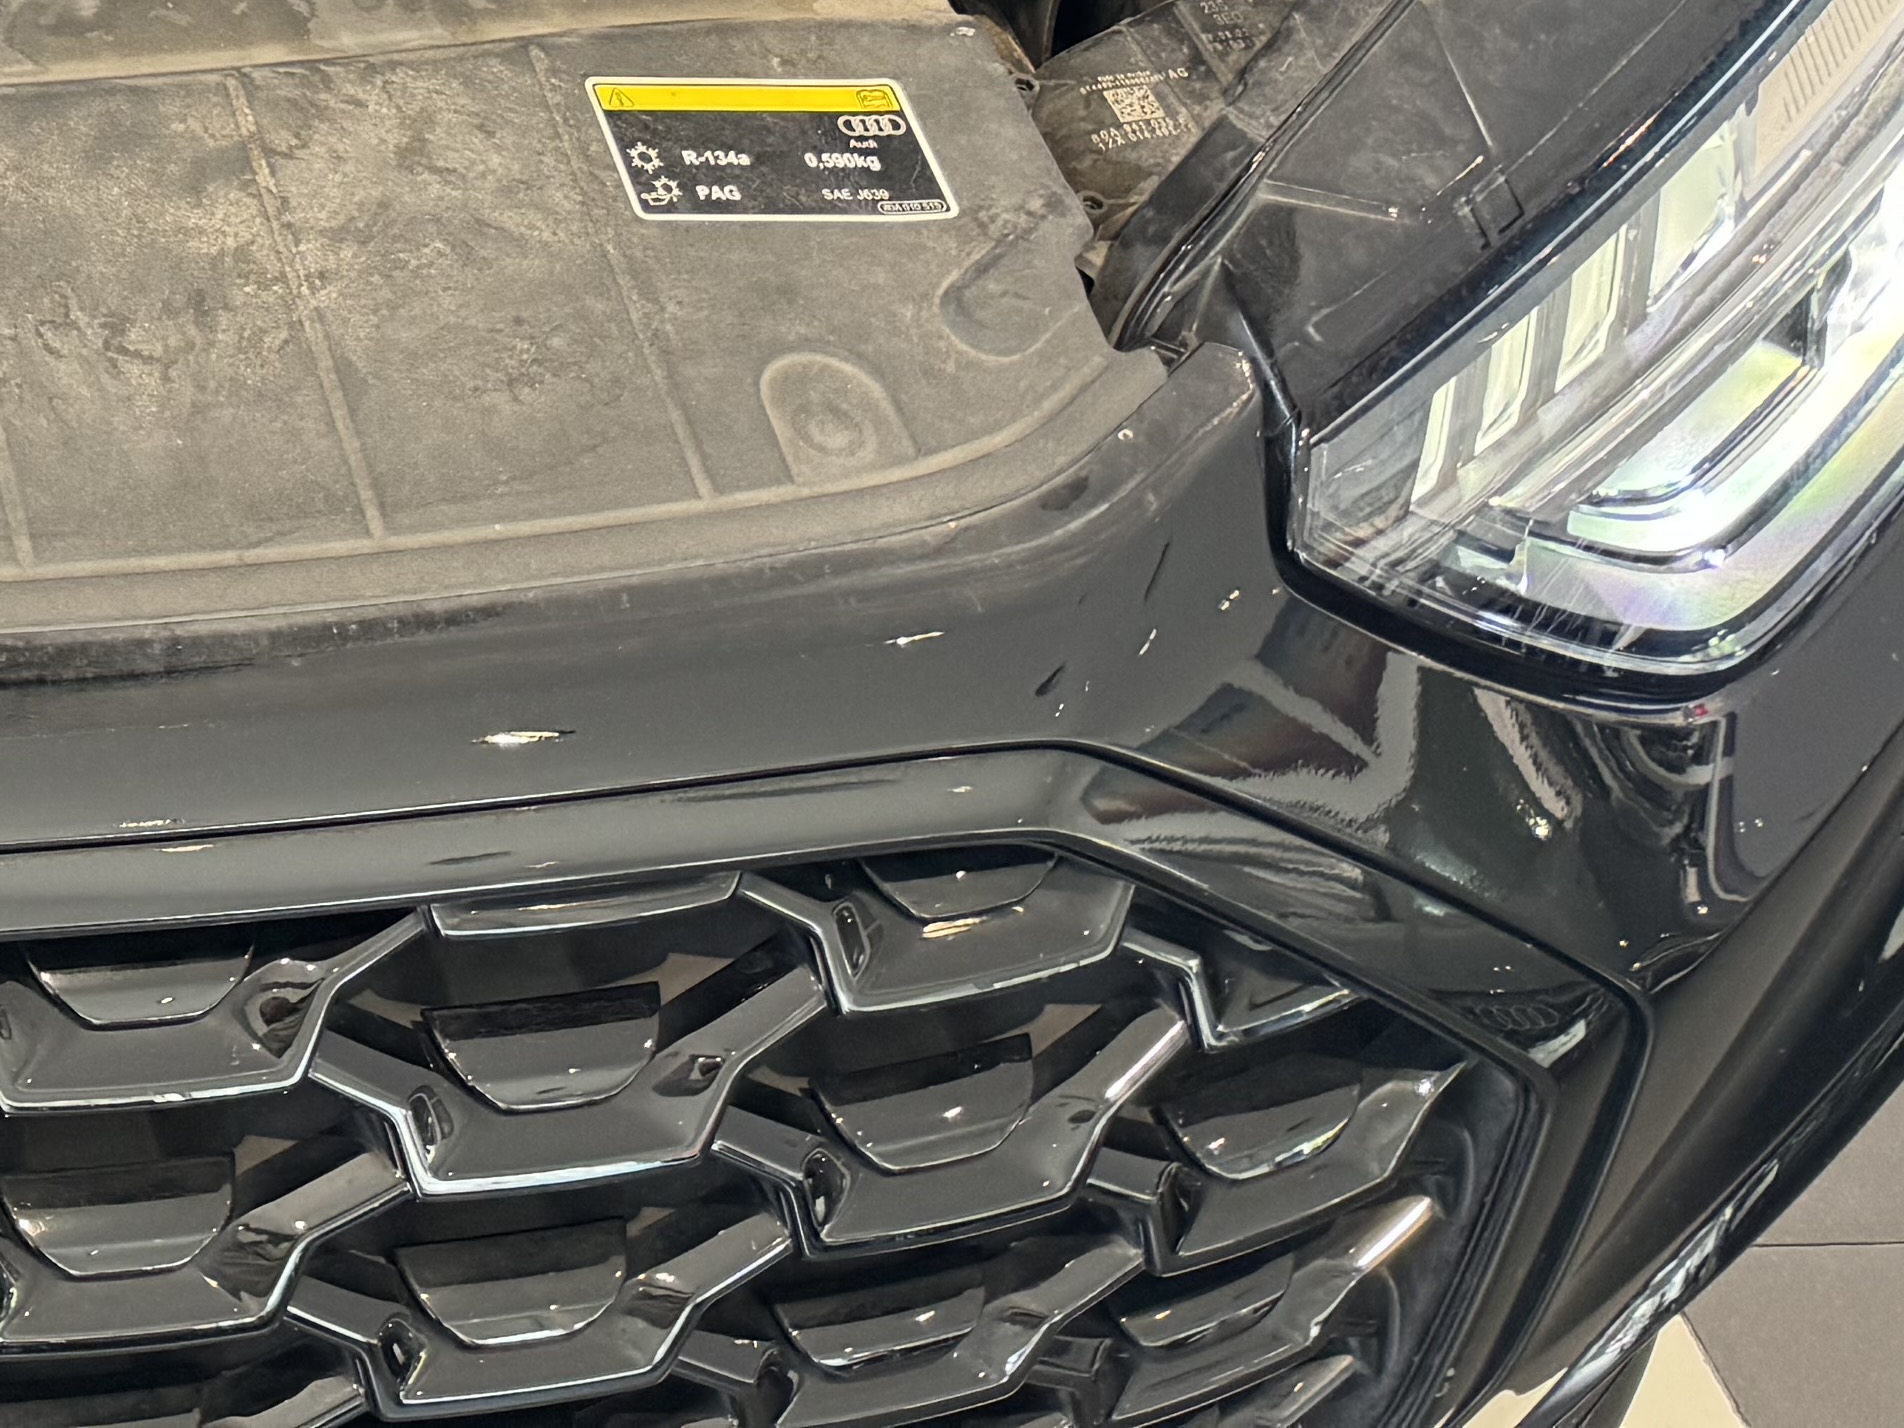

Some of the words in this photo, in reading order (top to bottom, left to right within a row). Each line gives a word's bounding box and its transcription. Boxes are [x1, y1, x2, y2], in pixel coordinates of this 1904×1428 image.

[848, 137, 878, 149] Audi
[681, 150, 751, 167] R-134a
[803, 152, 882, 171] 0,590kg
[696, 184, 742, 202] PAG
[821, 188, 852, 201] SAE
